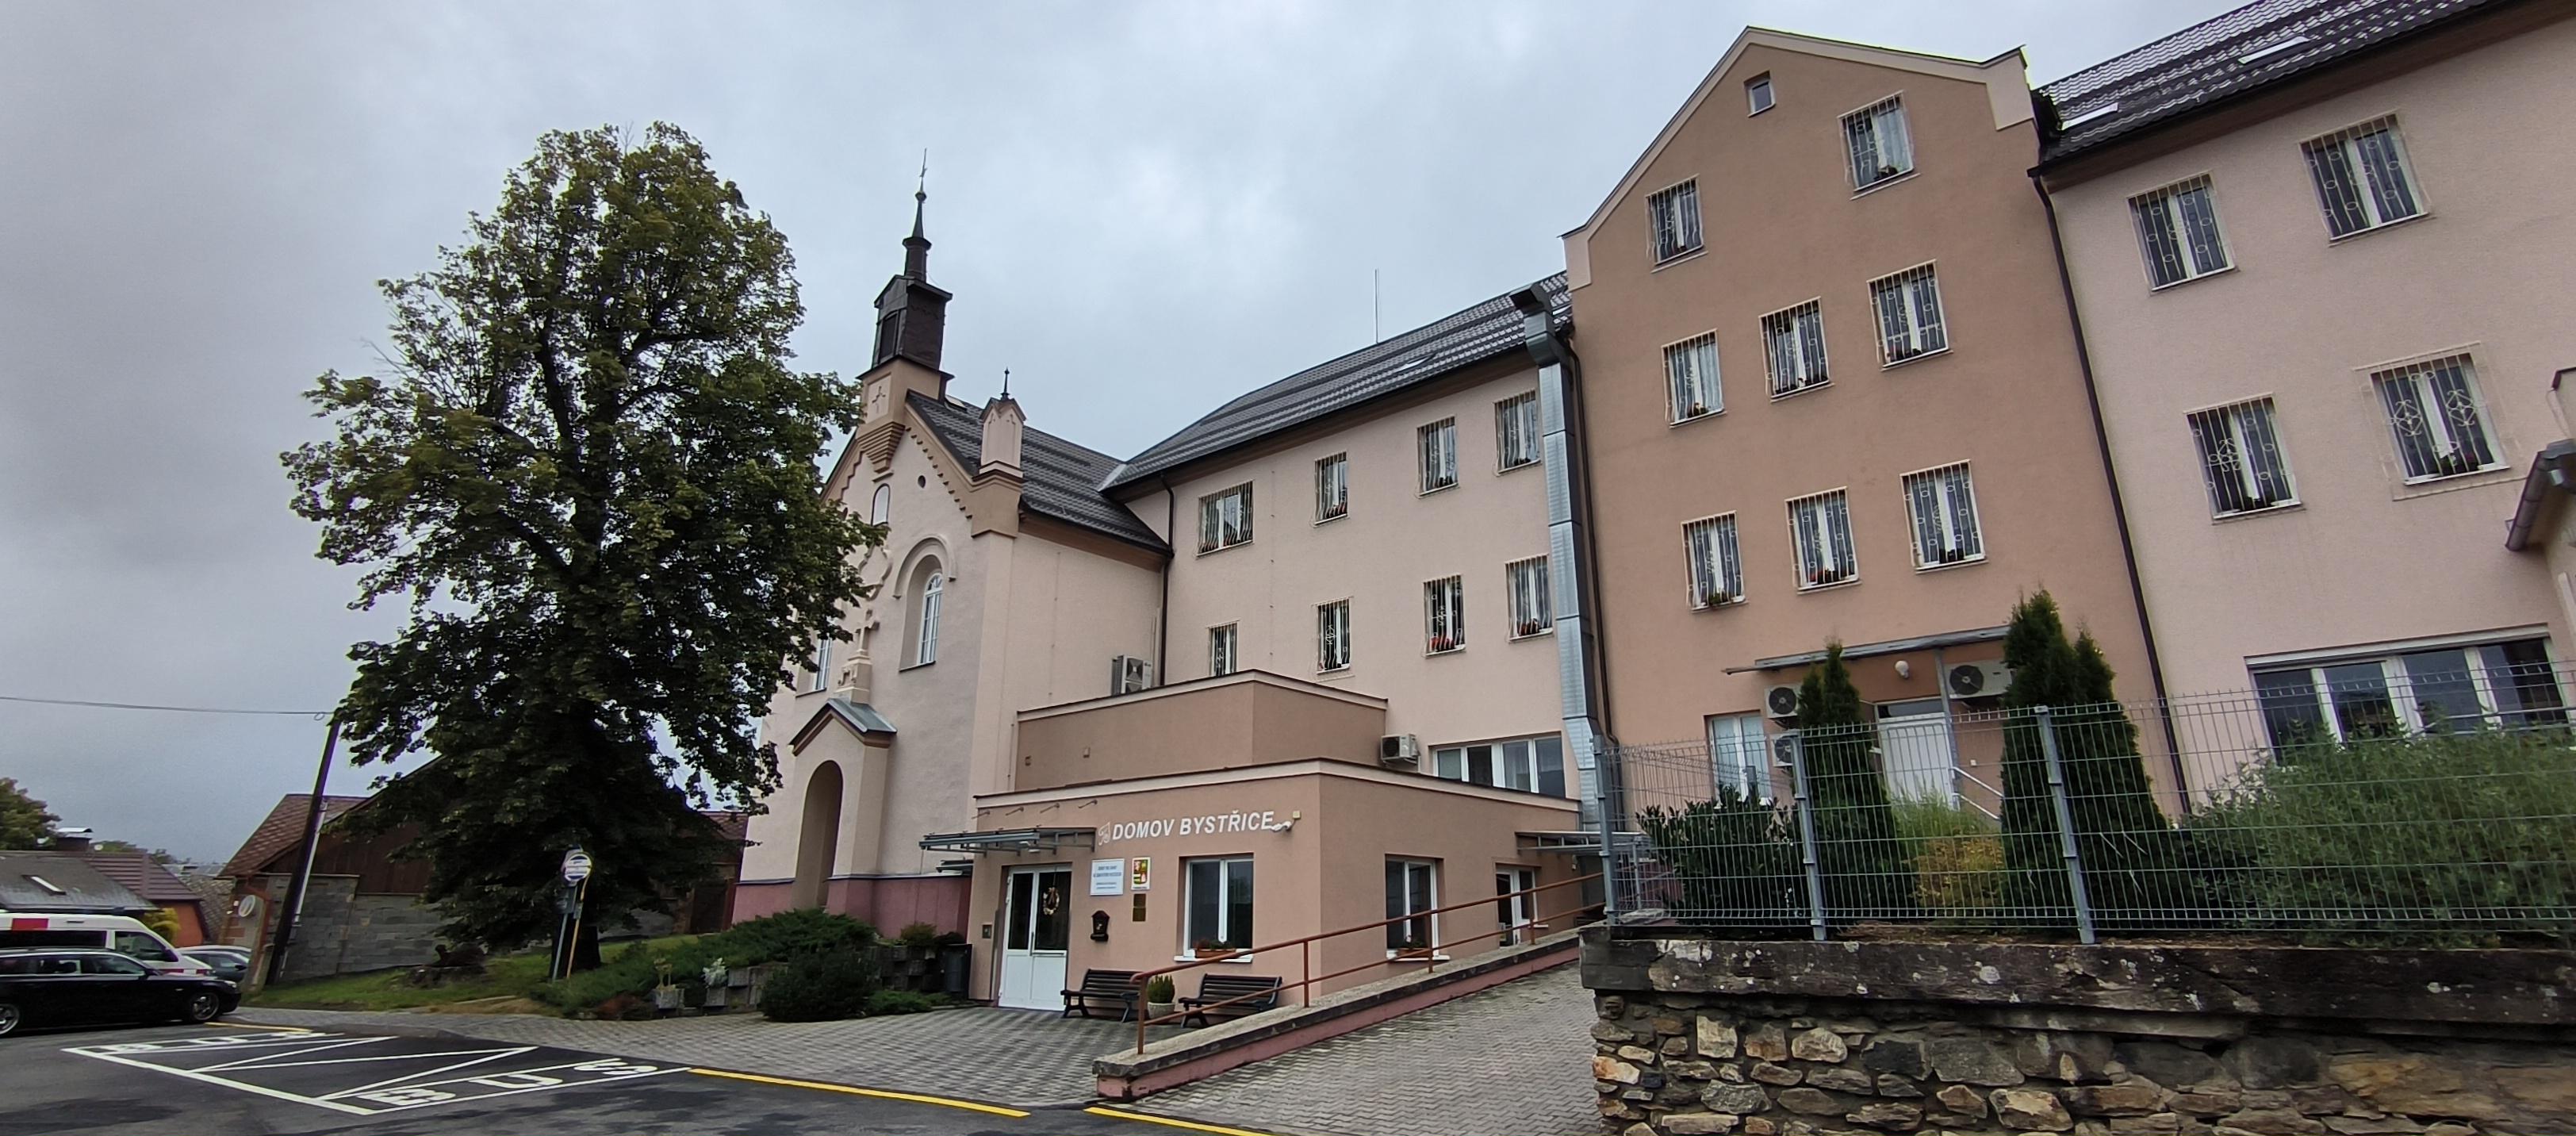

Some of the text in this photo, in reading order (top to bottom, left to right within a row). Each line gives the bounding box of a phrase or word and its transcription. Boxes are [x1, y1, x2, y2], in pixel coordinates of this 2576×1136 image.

[1112, 810, 1275, 841] DOMOV BYSTŘICE
[357, 1061, 658, 1106] BUS
